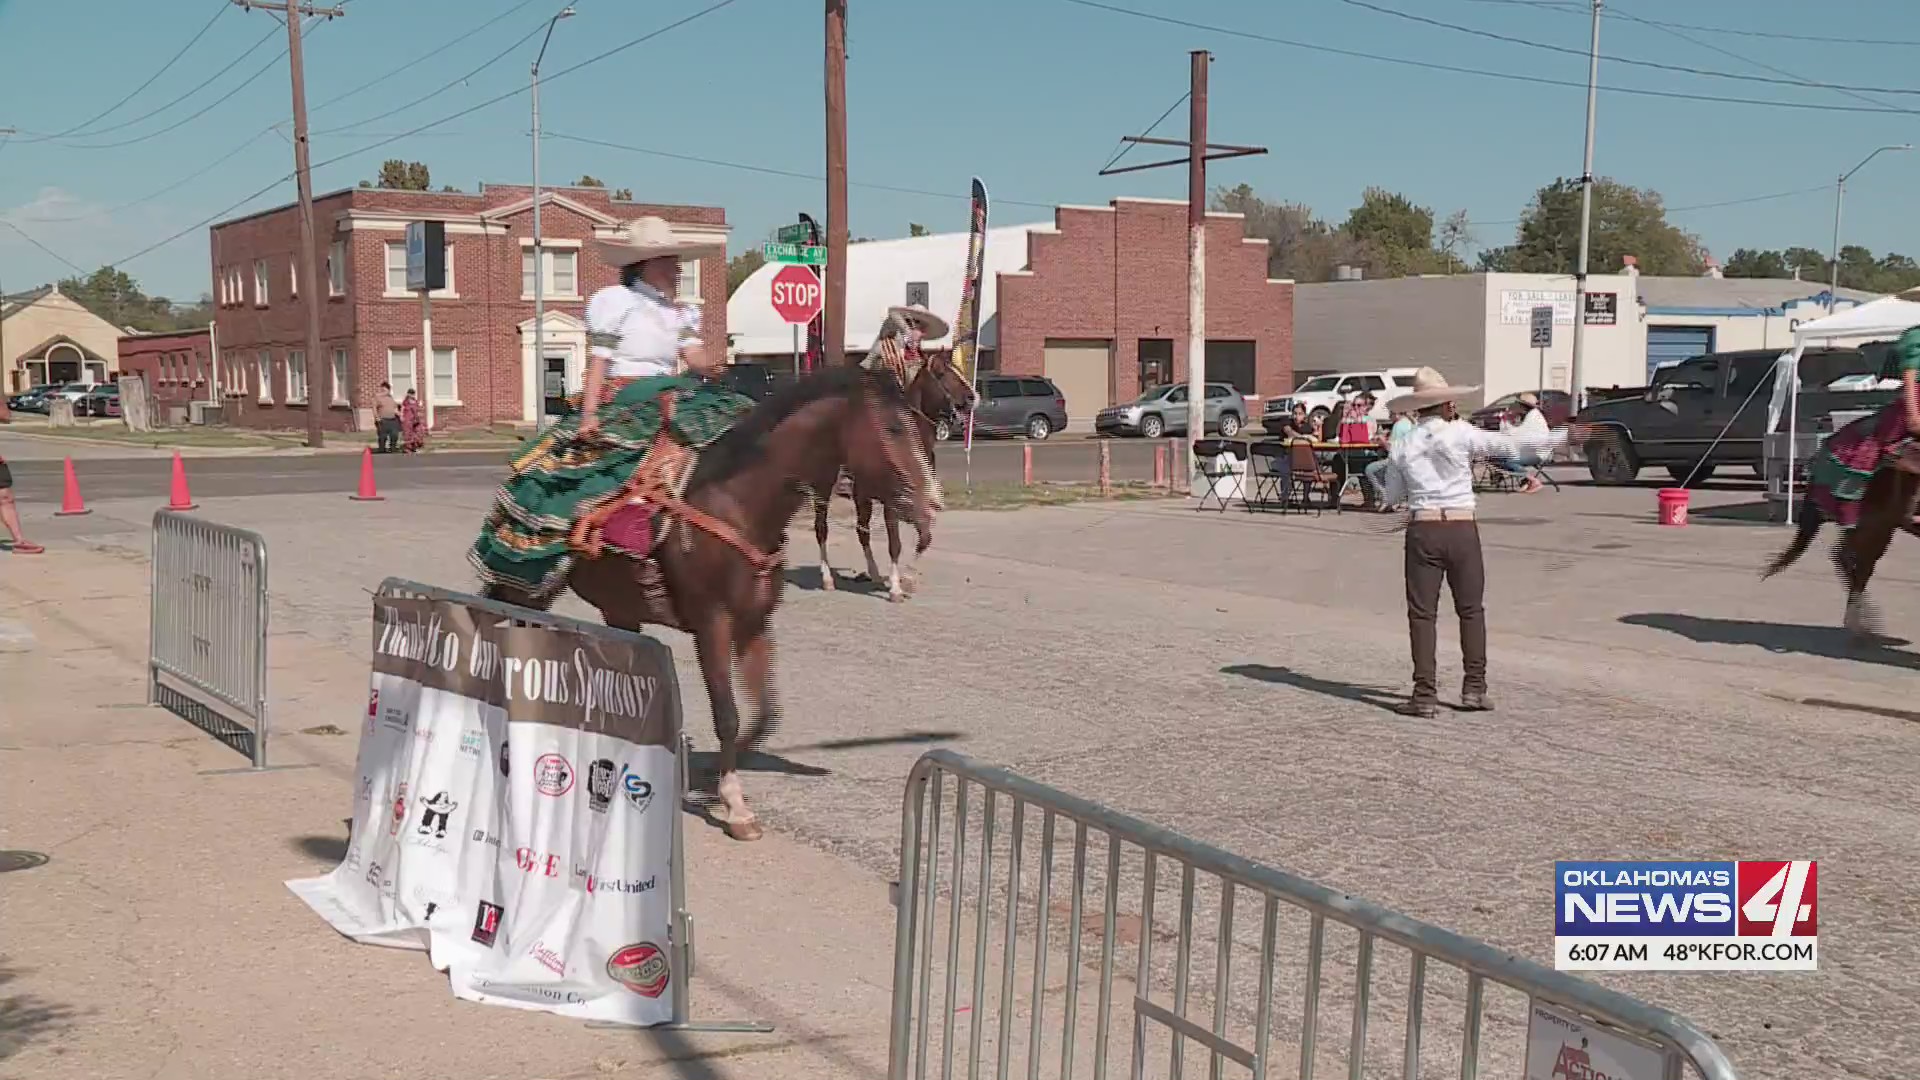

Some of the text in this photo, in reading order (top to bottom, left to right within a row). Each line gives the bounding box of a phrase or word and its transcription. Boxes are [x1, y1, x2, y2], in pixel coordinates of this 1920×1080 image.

[766, 242, 808, 257] EXCHAE
[773, 282, 819, 306] STOP
[1531, 327, 1550, 342] 25
[1534, 1007, 1582, 1033] PROPERTY OF
